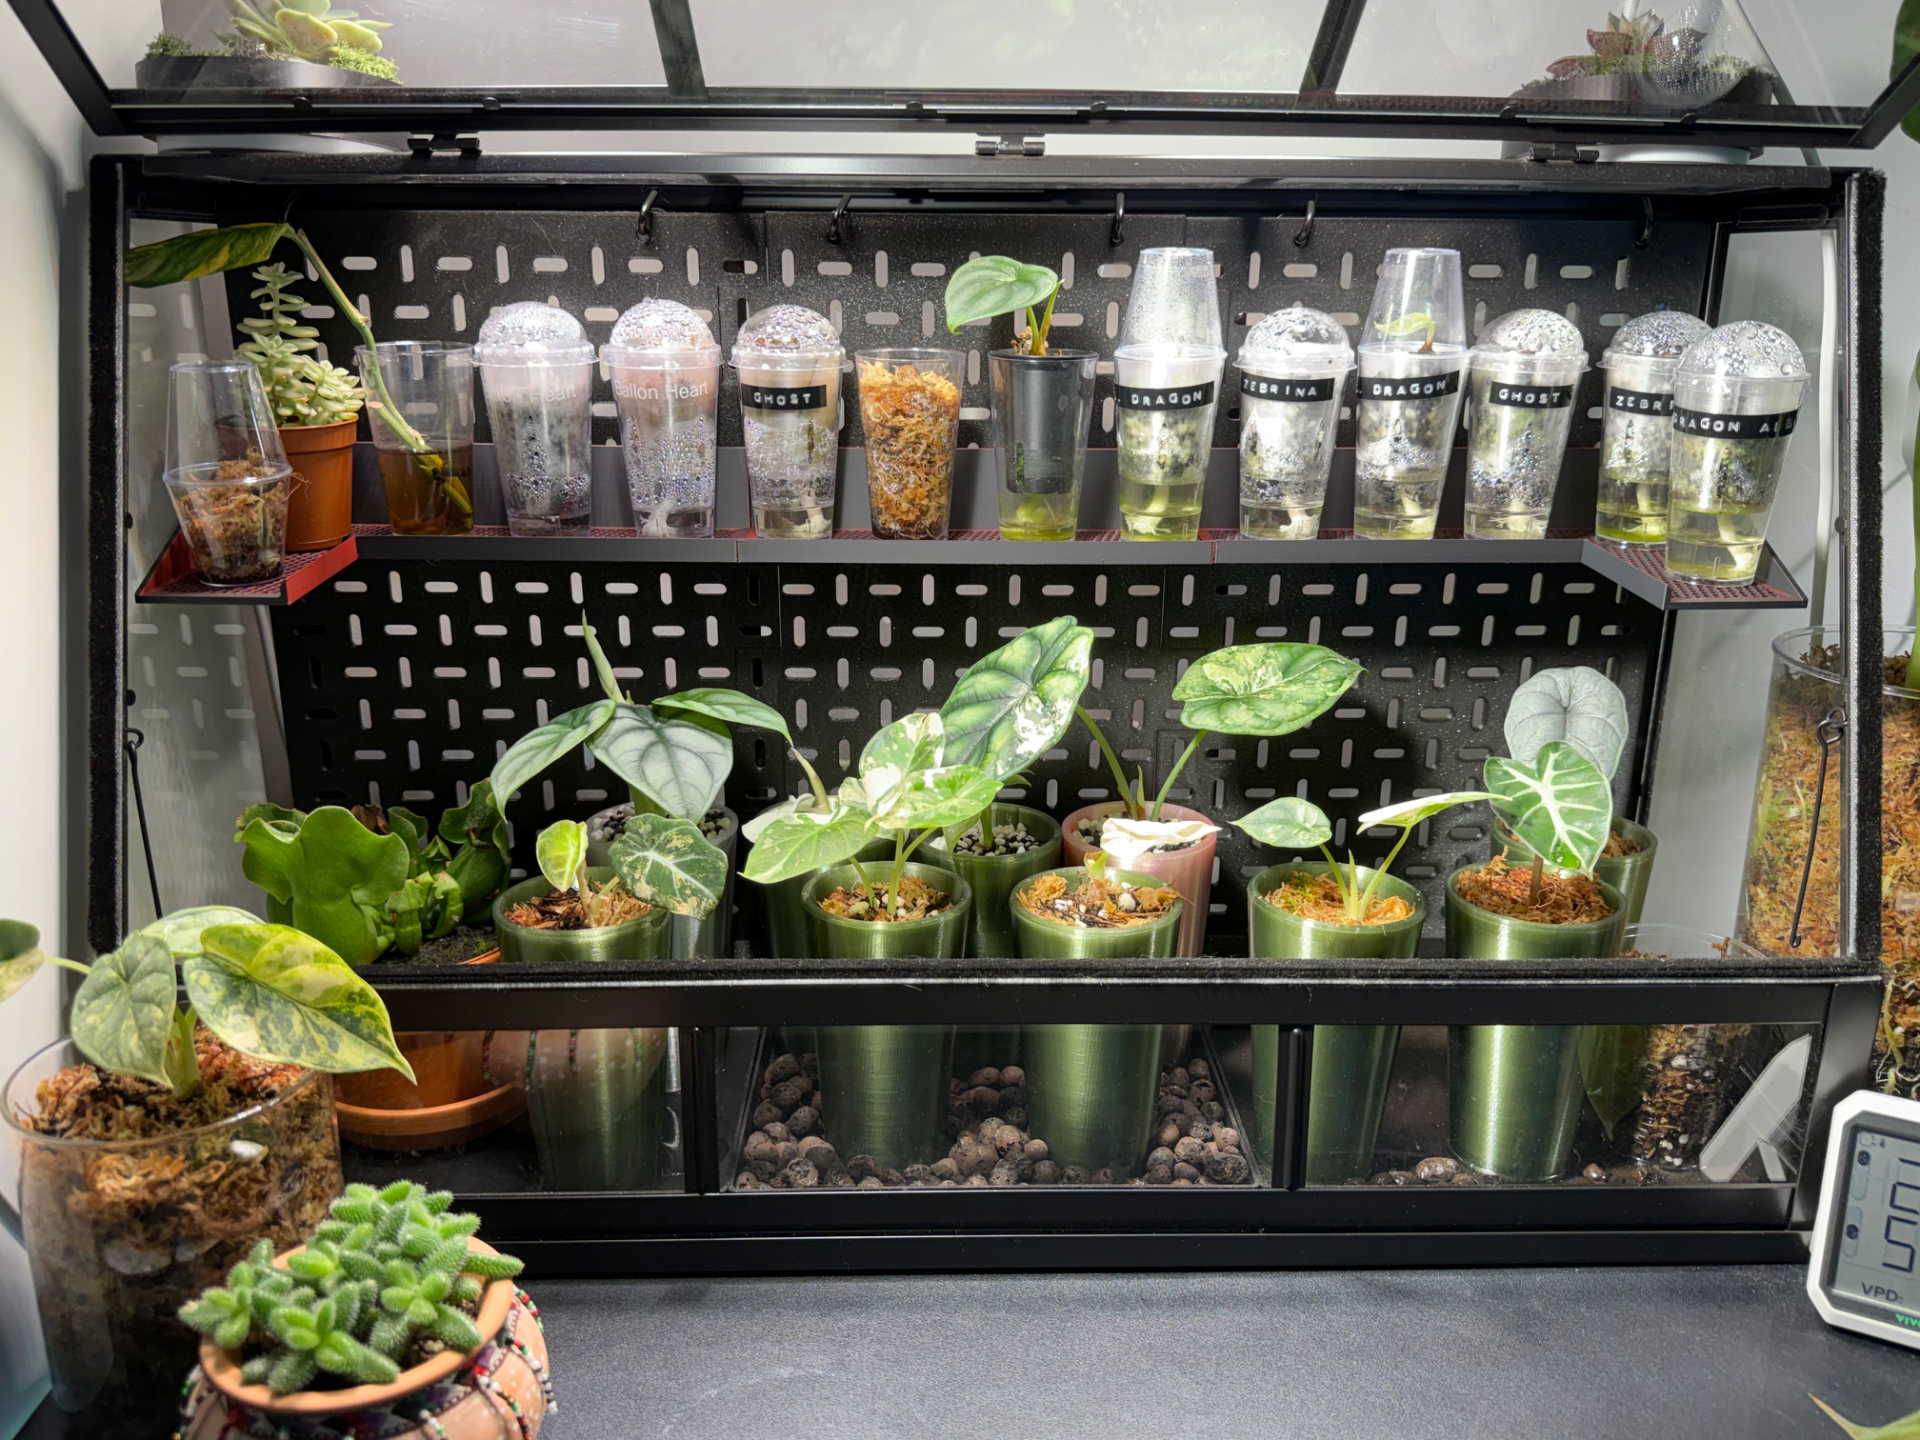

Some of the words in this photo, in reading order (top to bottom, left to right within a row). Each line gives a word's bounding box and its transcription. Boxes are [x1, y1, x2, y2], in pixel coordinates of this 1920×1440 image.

[530, 384, 577, 403] Heart
[614, 379, 659, 400] Ballon
[665, 380, 708, 400] Heart
[1243, 378, 1318, 398] ZEBRINA
[1372, 379, 1447, 397] DRAGON
[1498, 388, 1561, 404] GHOST
[753, 391, 812, 406] GHOST
[1131, 390, 1202, 406] DRAGON
[1673, 412, 1741, 433] DRAGON
[1861, 1281, 1903, 1305] VPD:
